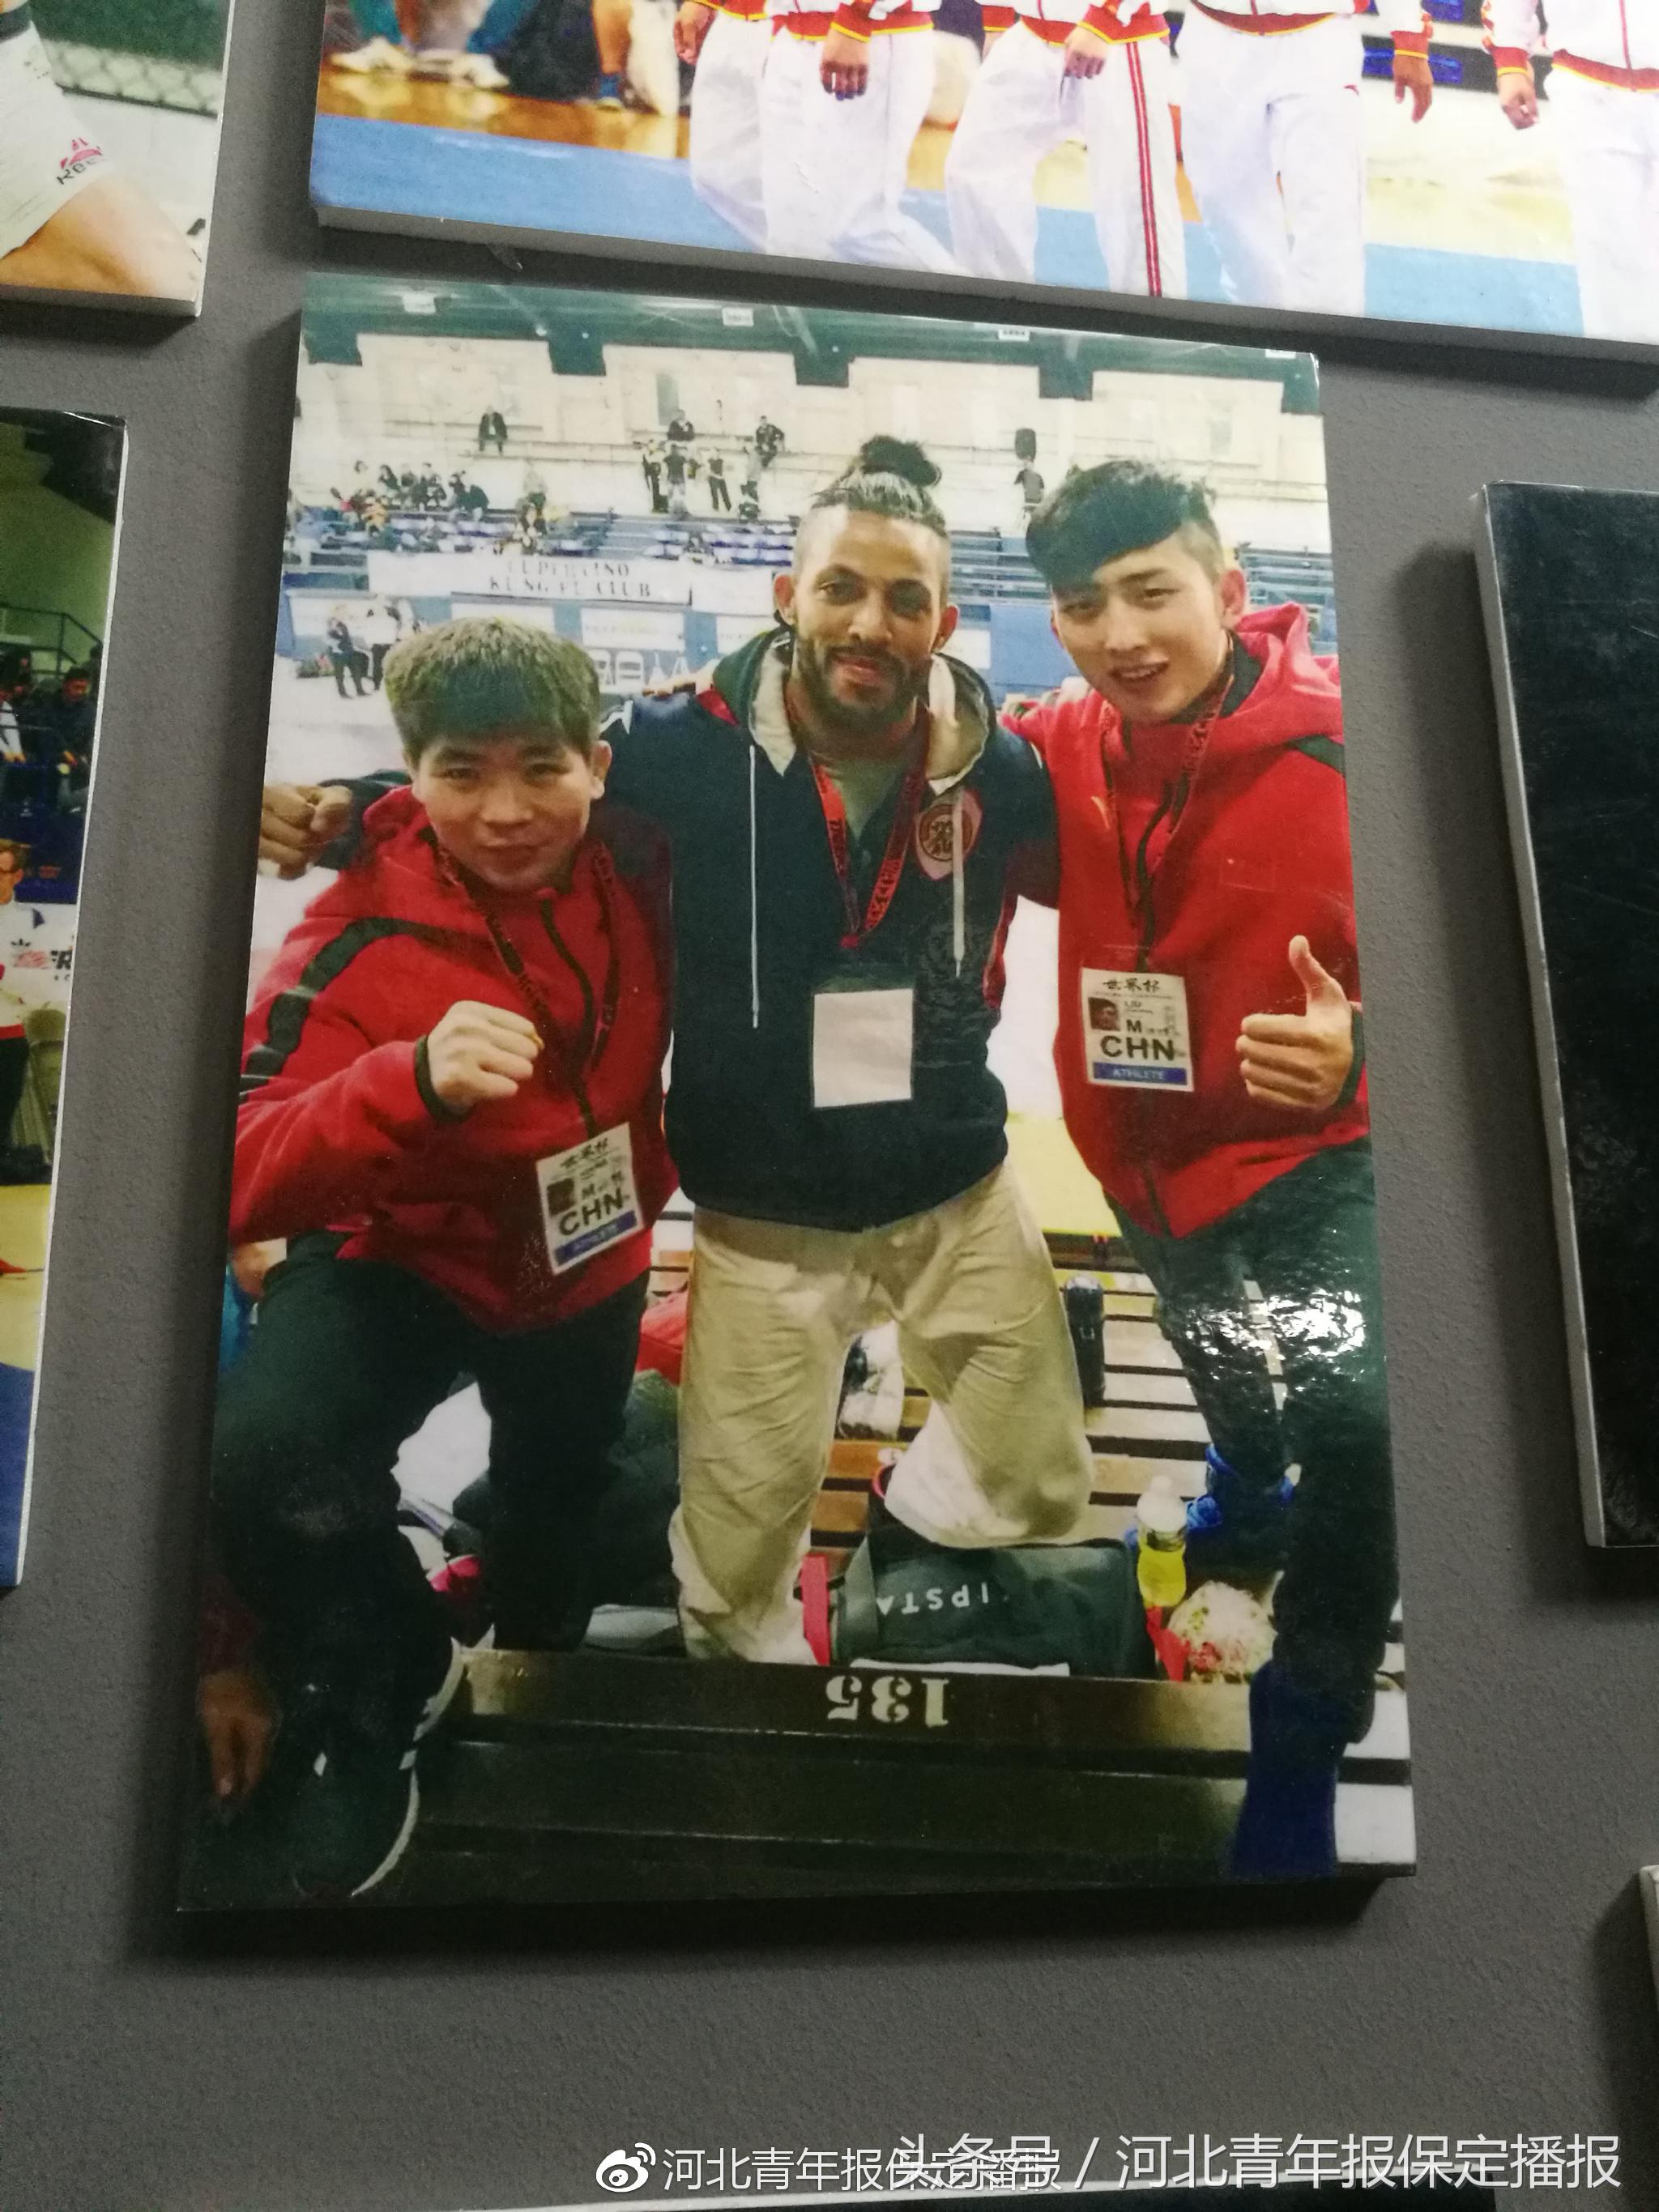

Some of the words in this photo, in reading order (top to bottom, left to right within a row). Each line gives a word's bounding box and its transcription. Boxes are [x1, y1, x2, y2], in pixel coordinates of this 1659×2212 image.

[1126, 1019, 1142, 1034] M
[1099, 1035, 1175, 1061] CHN
[1112, 1068, 1166, 1080] ATHLETE
[559, 1187, 623, 1236] CHN
[825, 1675, 949, 1728] 135
